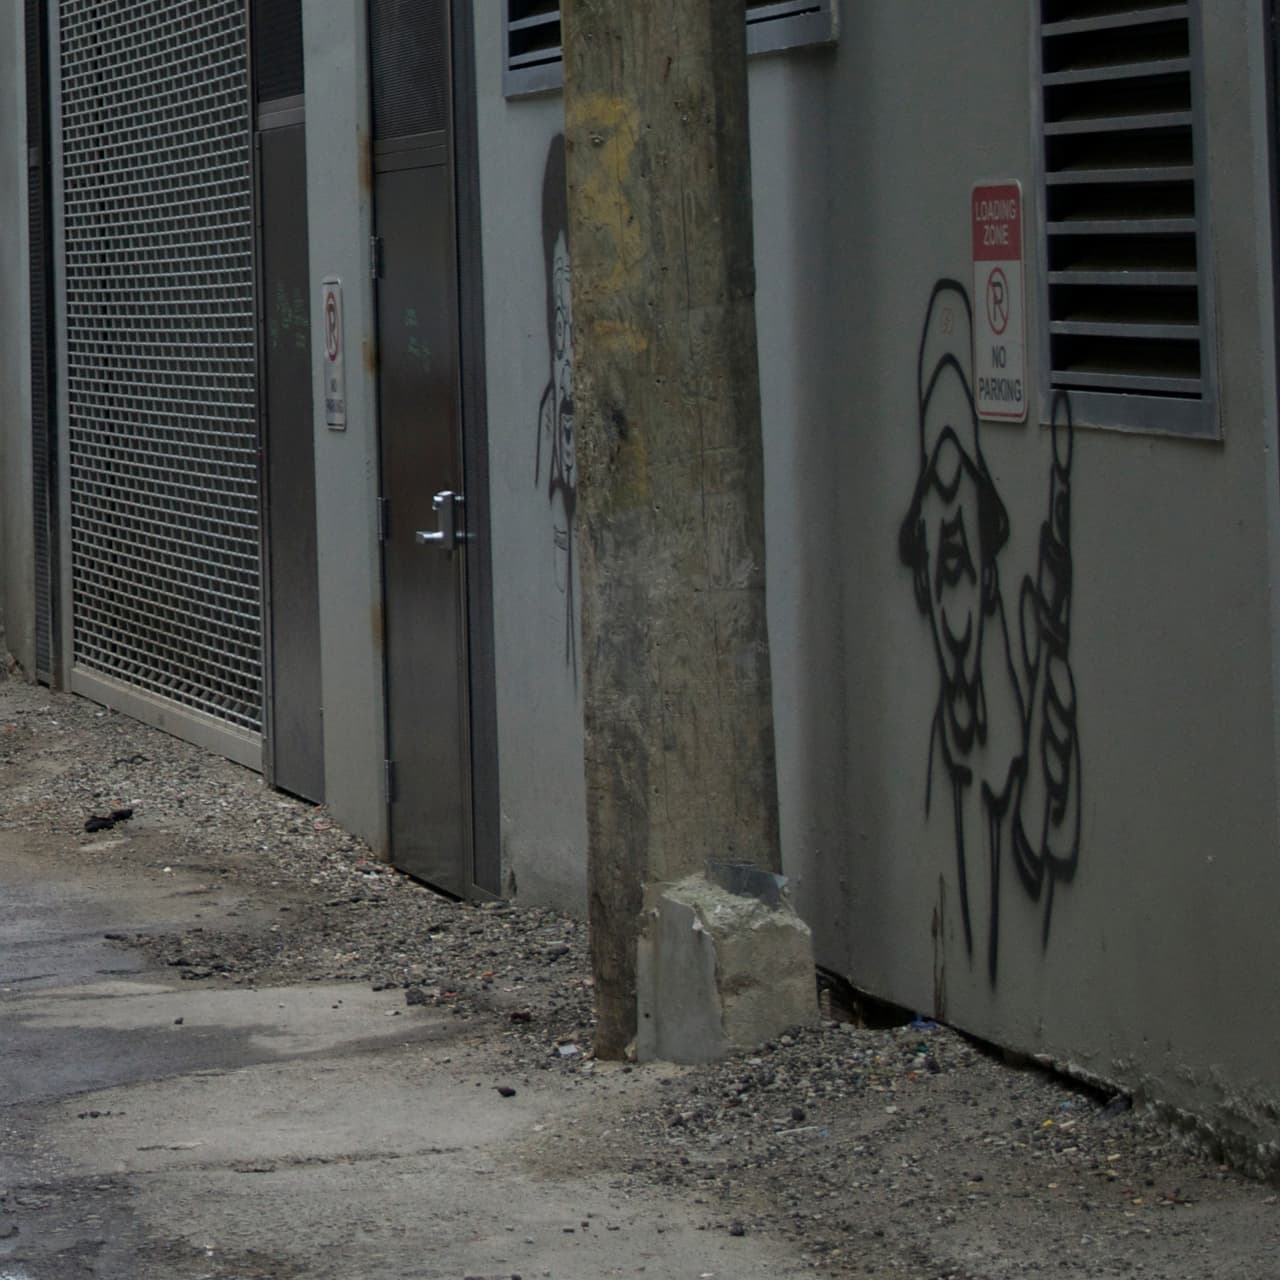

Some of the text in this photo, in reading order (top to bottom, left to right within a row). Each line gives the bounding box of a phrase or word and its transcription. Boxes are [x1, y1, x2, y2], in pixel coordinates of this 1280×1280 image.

[975, 200, 1016, 220] LOADING
[983, 225, 1009, 245] ZONE
[991, 346, 1006, 368] NO
[978, 377, 1022, 402] PARKING
